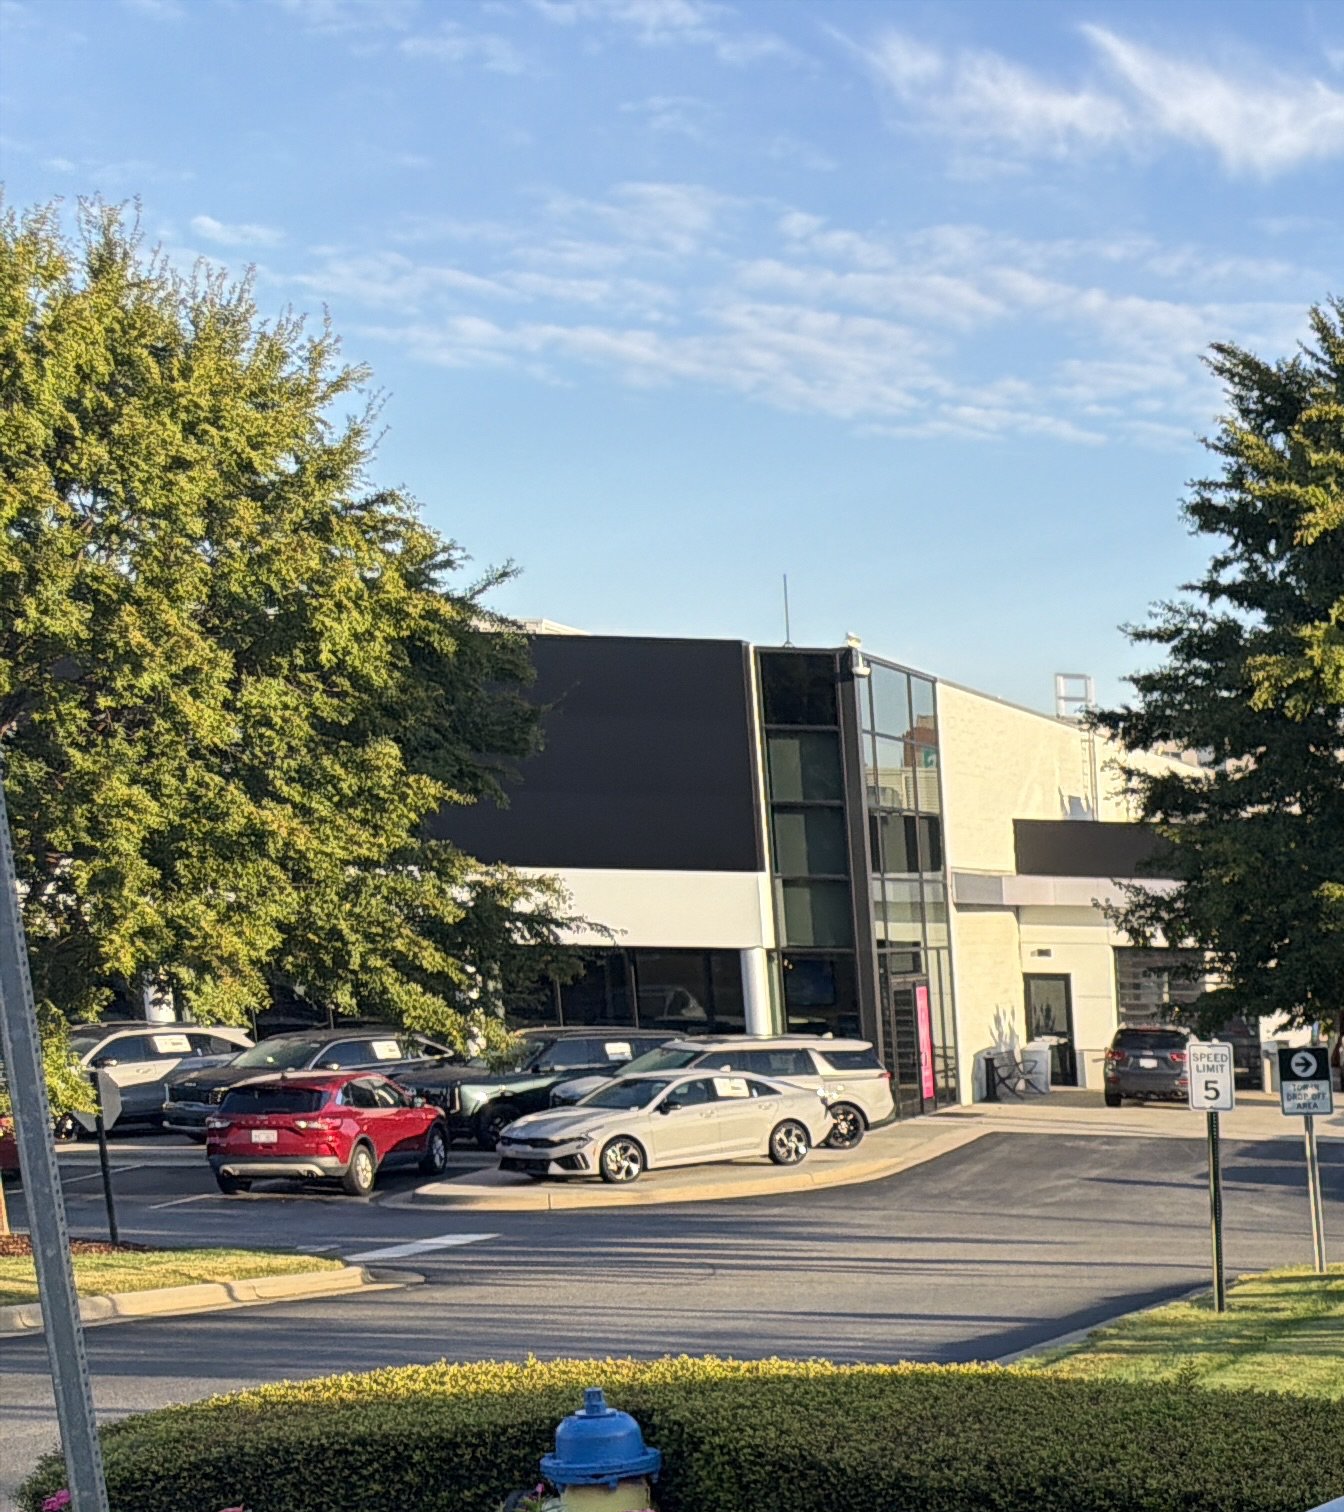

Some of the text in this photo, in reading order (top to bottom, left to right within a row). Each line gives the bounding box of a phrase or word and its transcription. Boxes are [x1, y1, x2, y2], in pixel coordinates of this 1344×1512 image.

[1192, 1052, 1229, 1063] SPEED
[1195, 1063, 1225, 1074] LIMIT
[1204, 1079, 1220, 1101] 5
[1296, 1102, 1319, 1110] AREA
